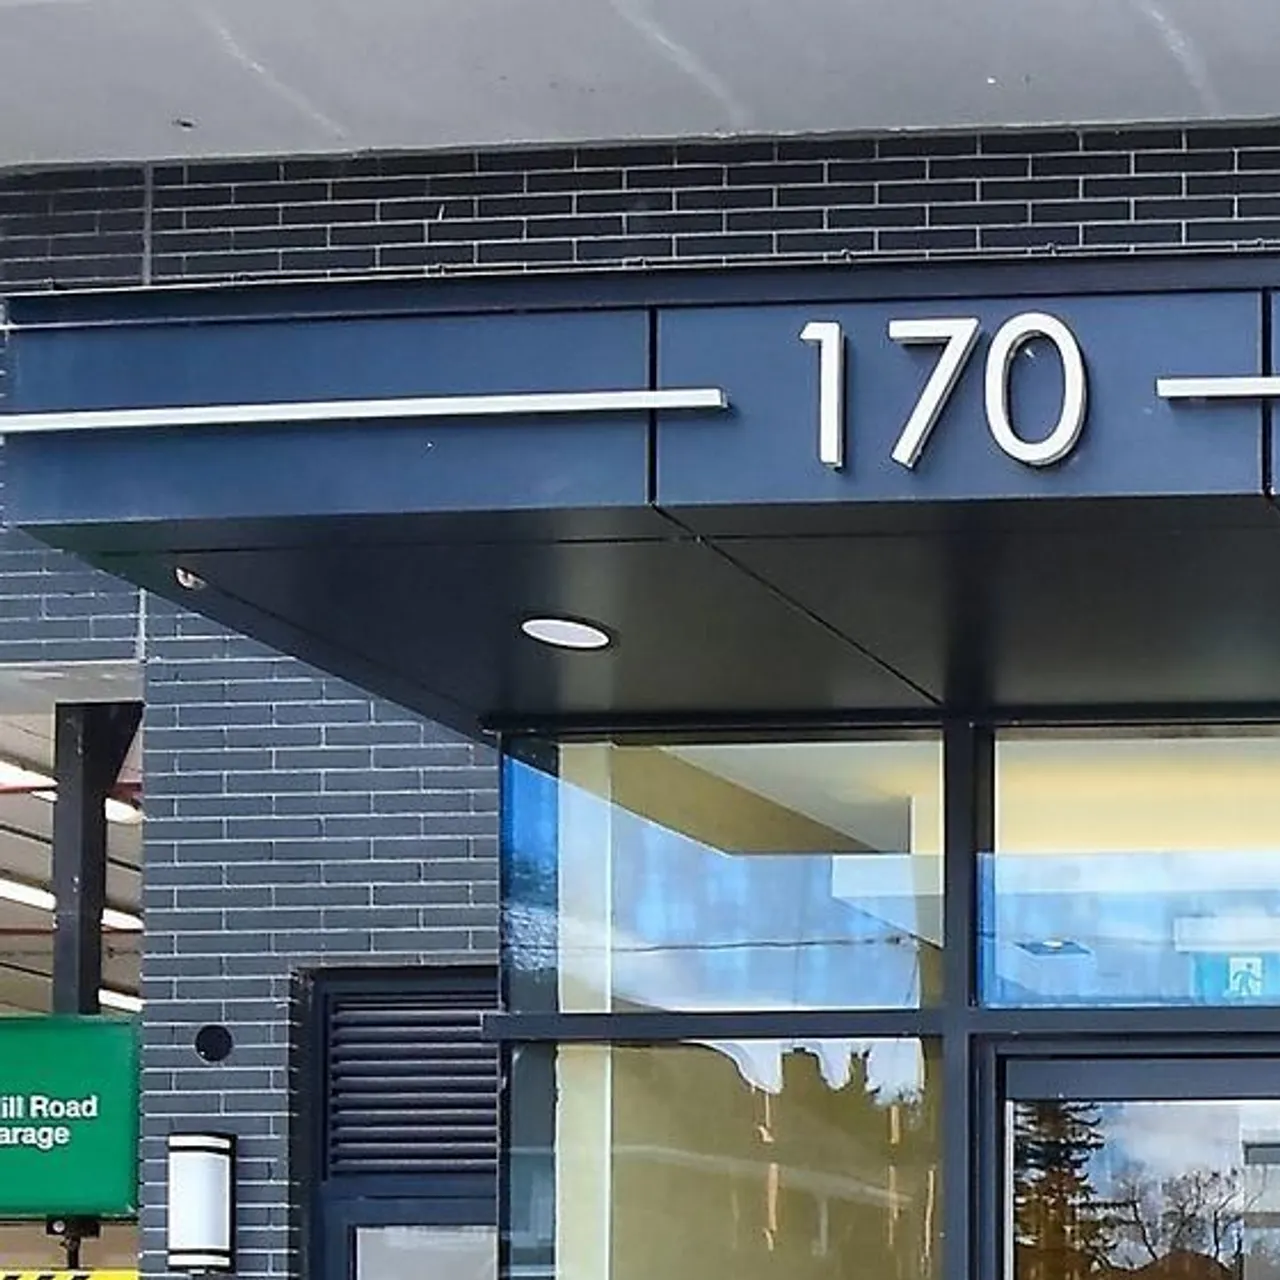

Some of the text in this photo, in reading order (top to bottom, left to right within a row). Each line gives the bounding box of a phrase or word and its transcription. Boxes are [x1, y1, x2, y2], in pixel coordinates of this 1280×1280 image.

[800, 312, 1087, 468] 170
[0, 1095, 98, 1118] ill Road
[0, 1126, 70, 1149] arage
